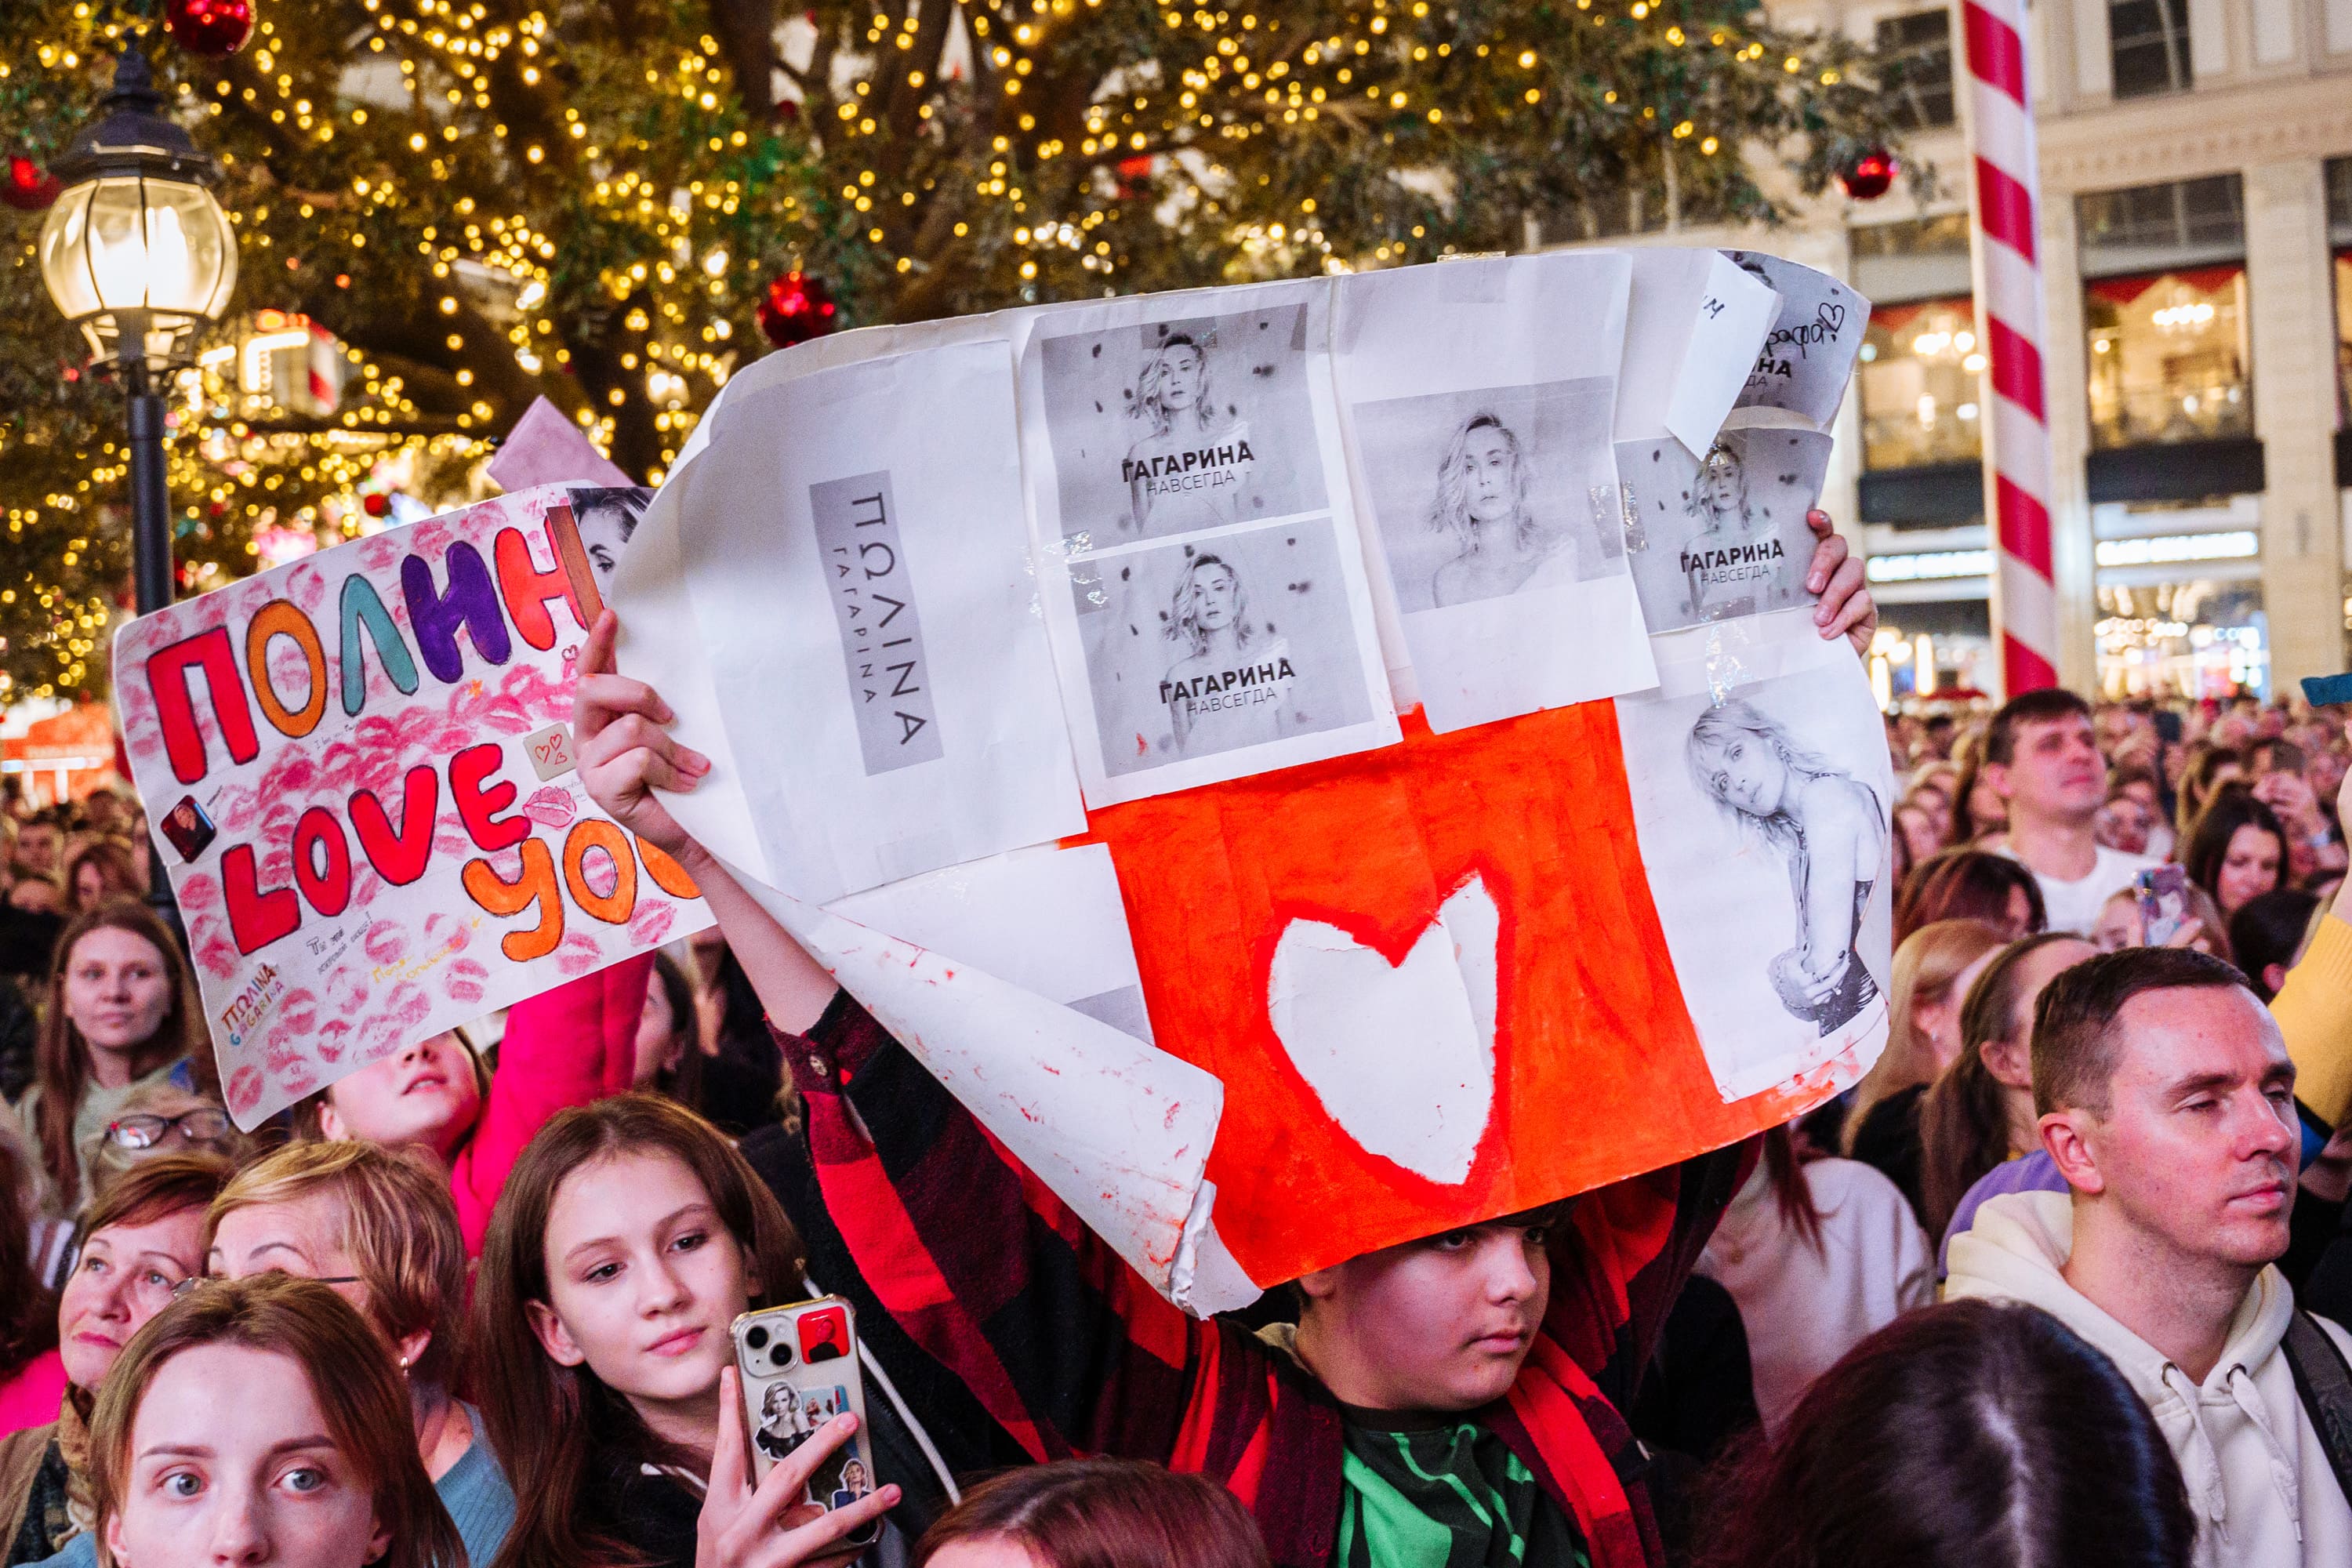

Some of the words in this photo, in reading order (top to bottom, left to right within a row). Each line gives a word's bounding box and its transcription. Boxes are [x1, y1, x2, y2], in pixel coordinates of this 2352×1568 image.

[1121, 441, 1255, 483] ГАГАРИНА
[1145, 469, 1236, 497] НАВСЕГДА
[1680, 540, 1785, 573] ГАГАРИНА
[1700, 564, 1771, 584] НАВСЕГДА
[1160, 658, 1296, 704] ГАГАРИНА
[1185, 687, 1279, 717] НАВСЕГДА
[222, 742, 532, 956] LOVE
[230, 980, 285, 1047] GAGARINA
